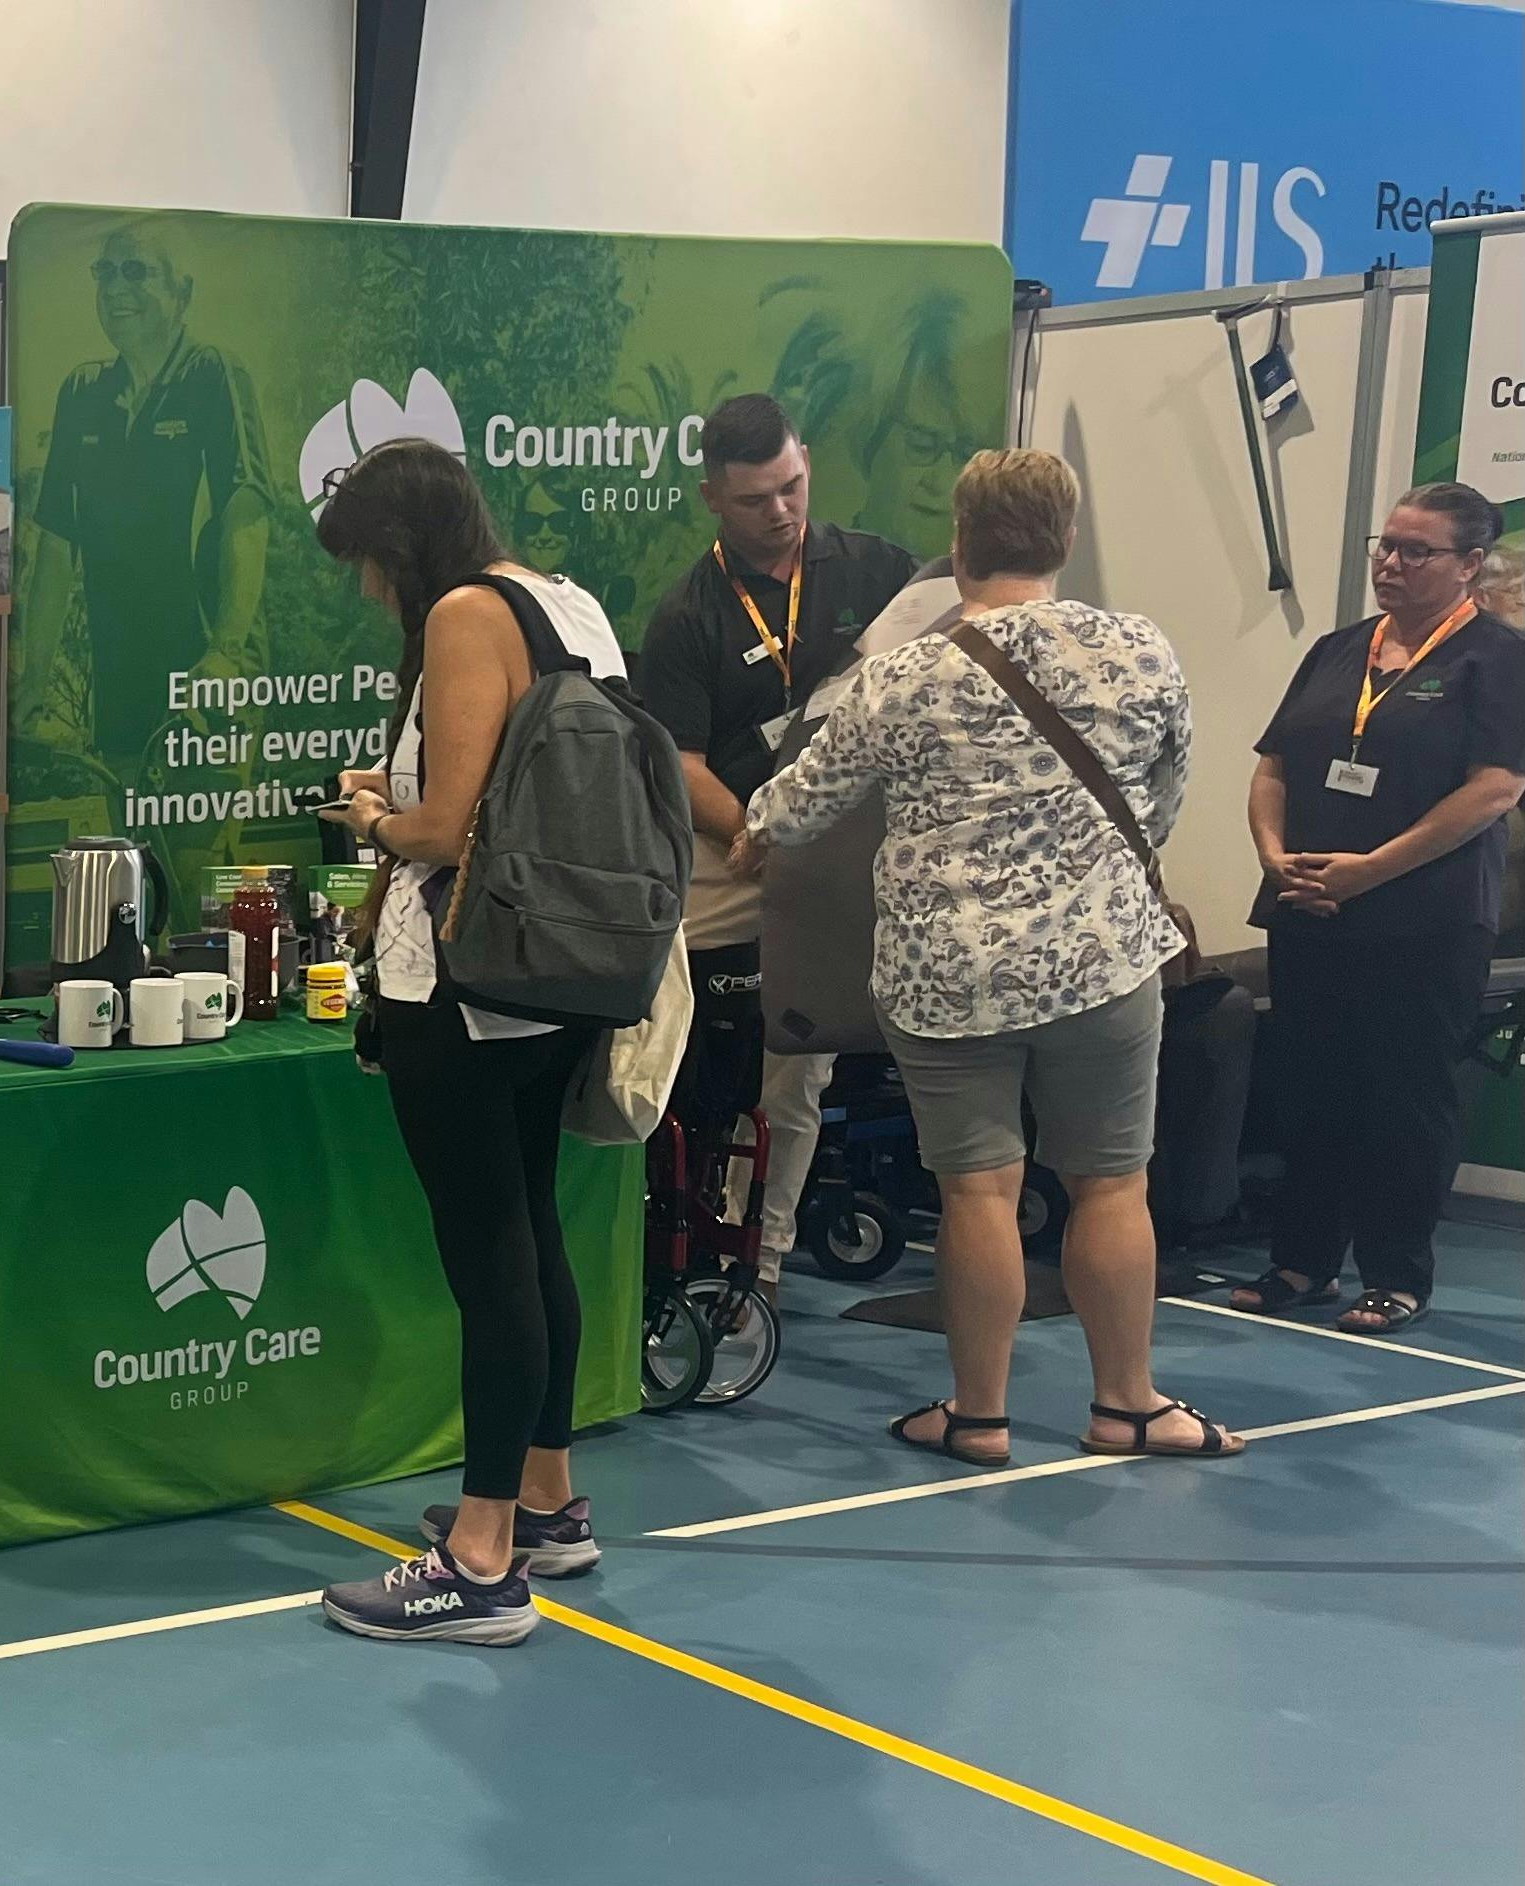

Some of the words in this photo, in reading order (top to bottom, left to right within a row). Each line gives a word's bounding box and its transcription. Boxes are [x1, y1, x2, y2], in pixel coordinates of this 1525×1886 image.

[485, 414, 669, 479] Country
[581, 488, 681, 512] GROUP
[168, 671, 343, 716] Empower
[353, 665, 401, 702] Pe
[165, 725, 254, 768] their
[263, 718, 388, 767] everyd
[93, 1338, 237, 1388] Country
[245, 1326, 321, 1366] Care
[170, 1380, 249, 1410] GROUP
[404, 1591, 464, 1617] HOKA
